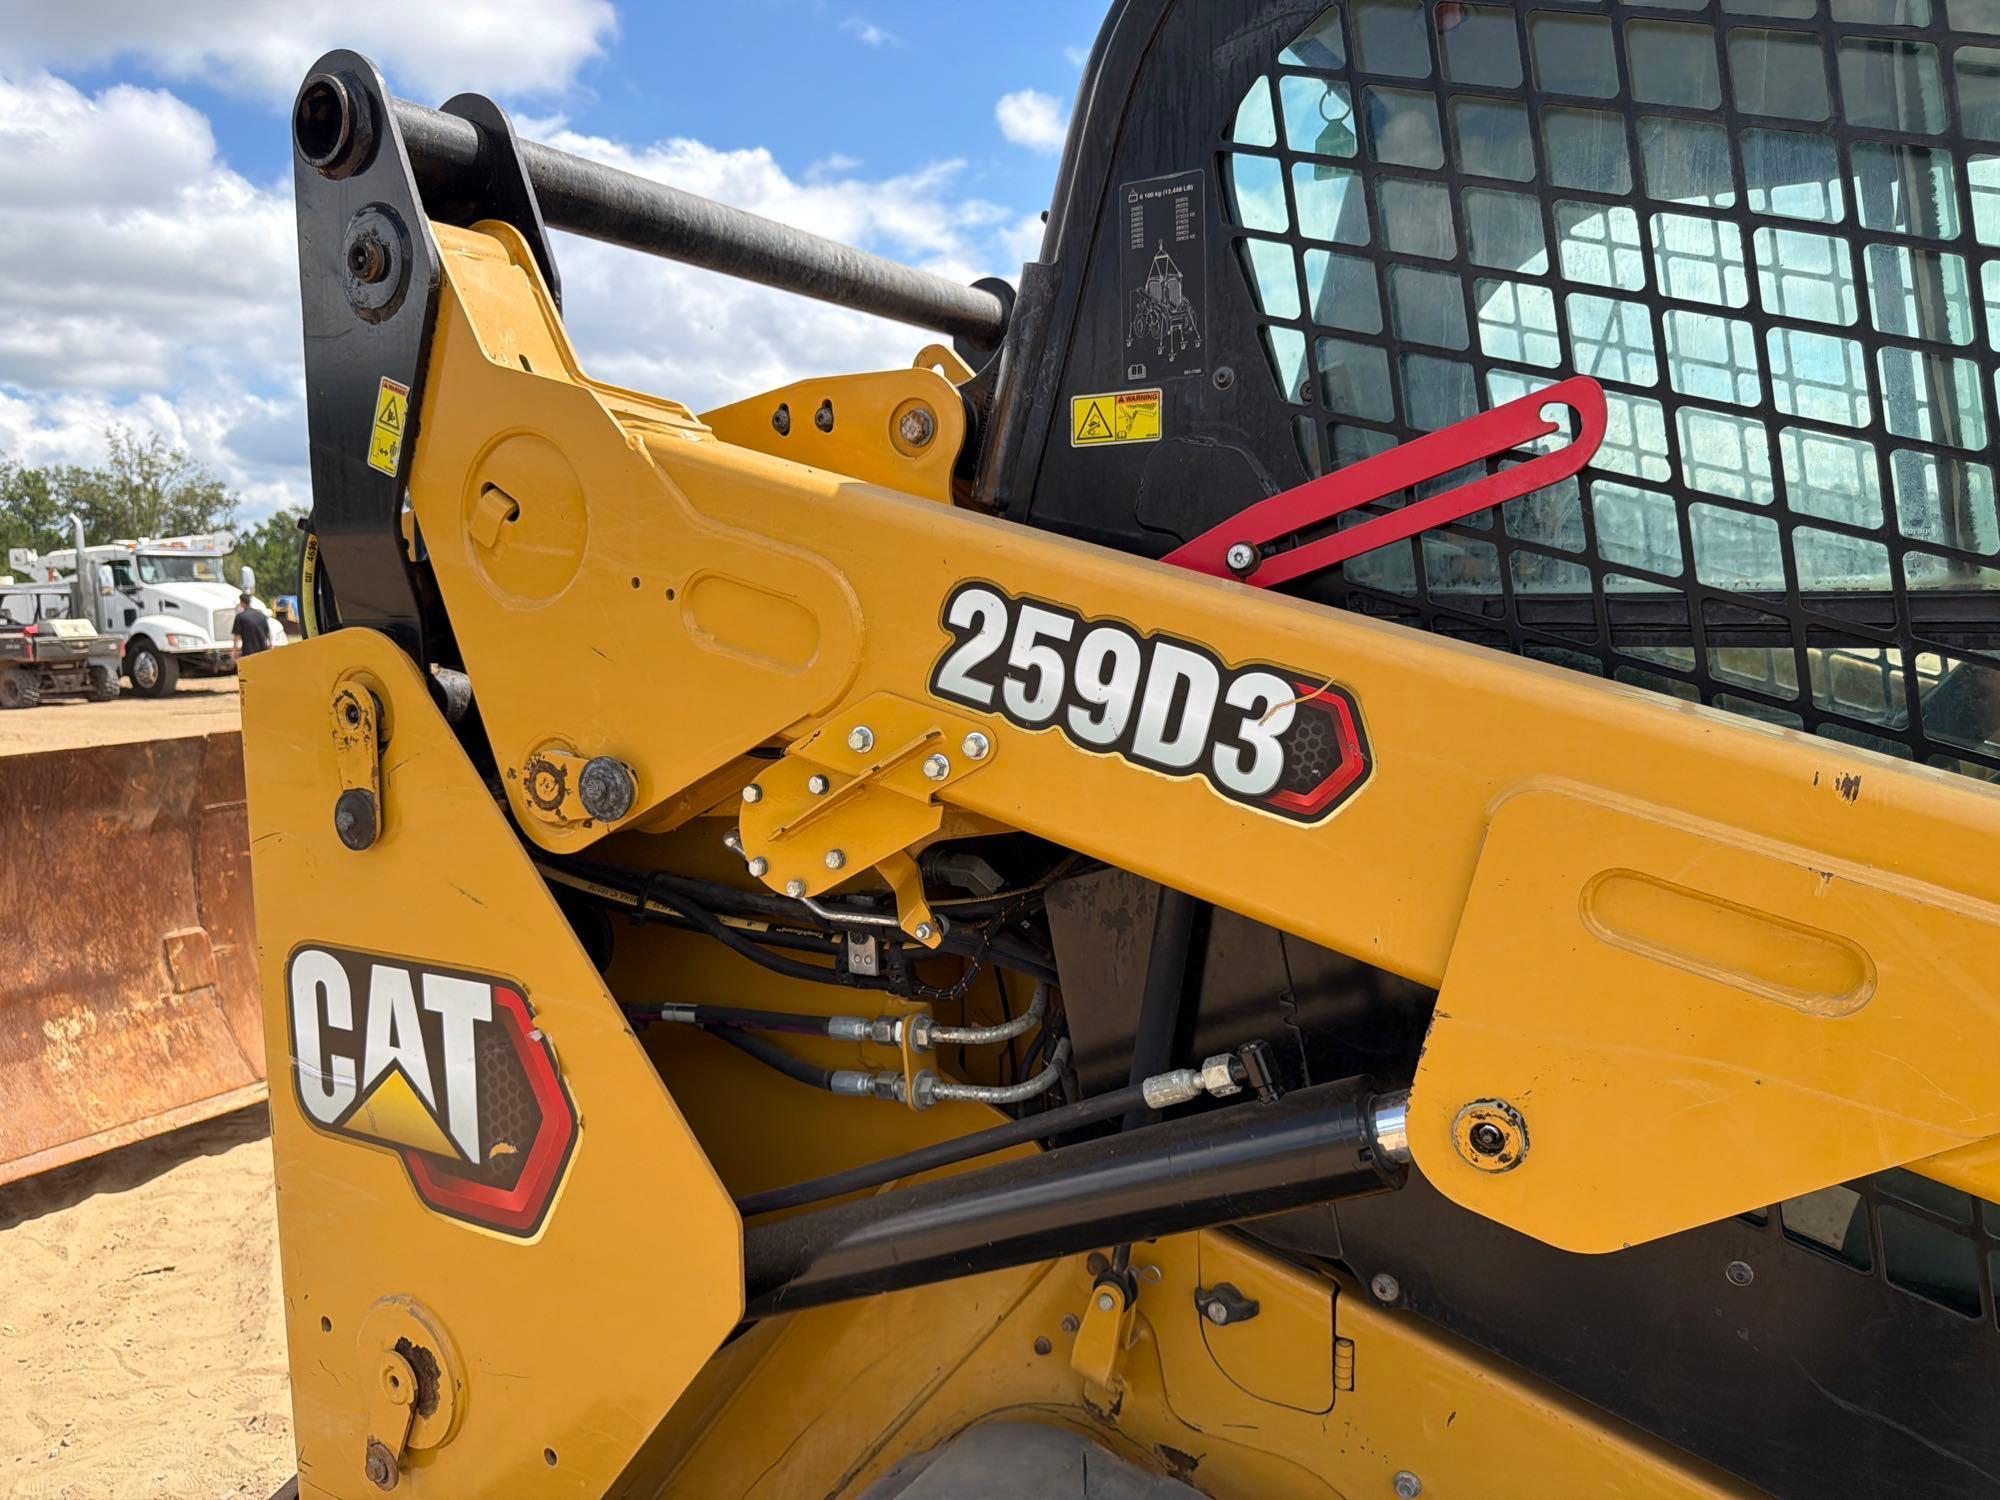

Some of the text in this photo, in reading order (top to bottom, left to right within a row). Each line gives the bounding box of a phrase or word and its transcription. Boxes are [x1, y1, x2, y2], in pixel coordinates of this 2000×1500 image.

[1125, 393, 1158, 402] WARNING
[937, 589, 1296, 795] 259D3
[292, 949, 493, 1165] CAT
